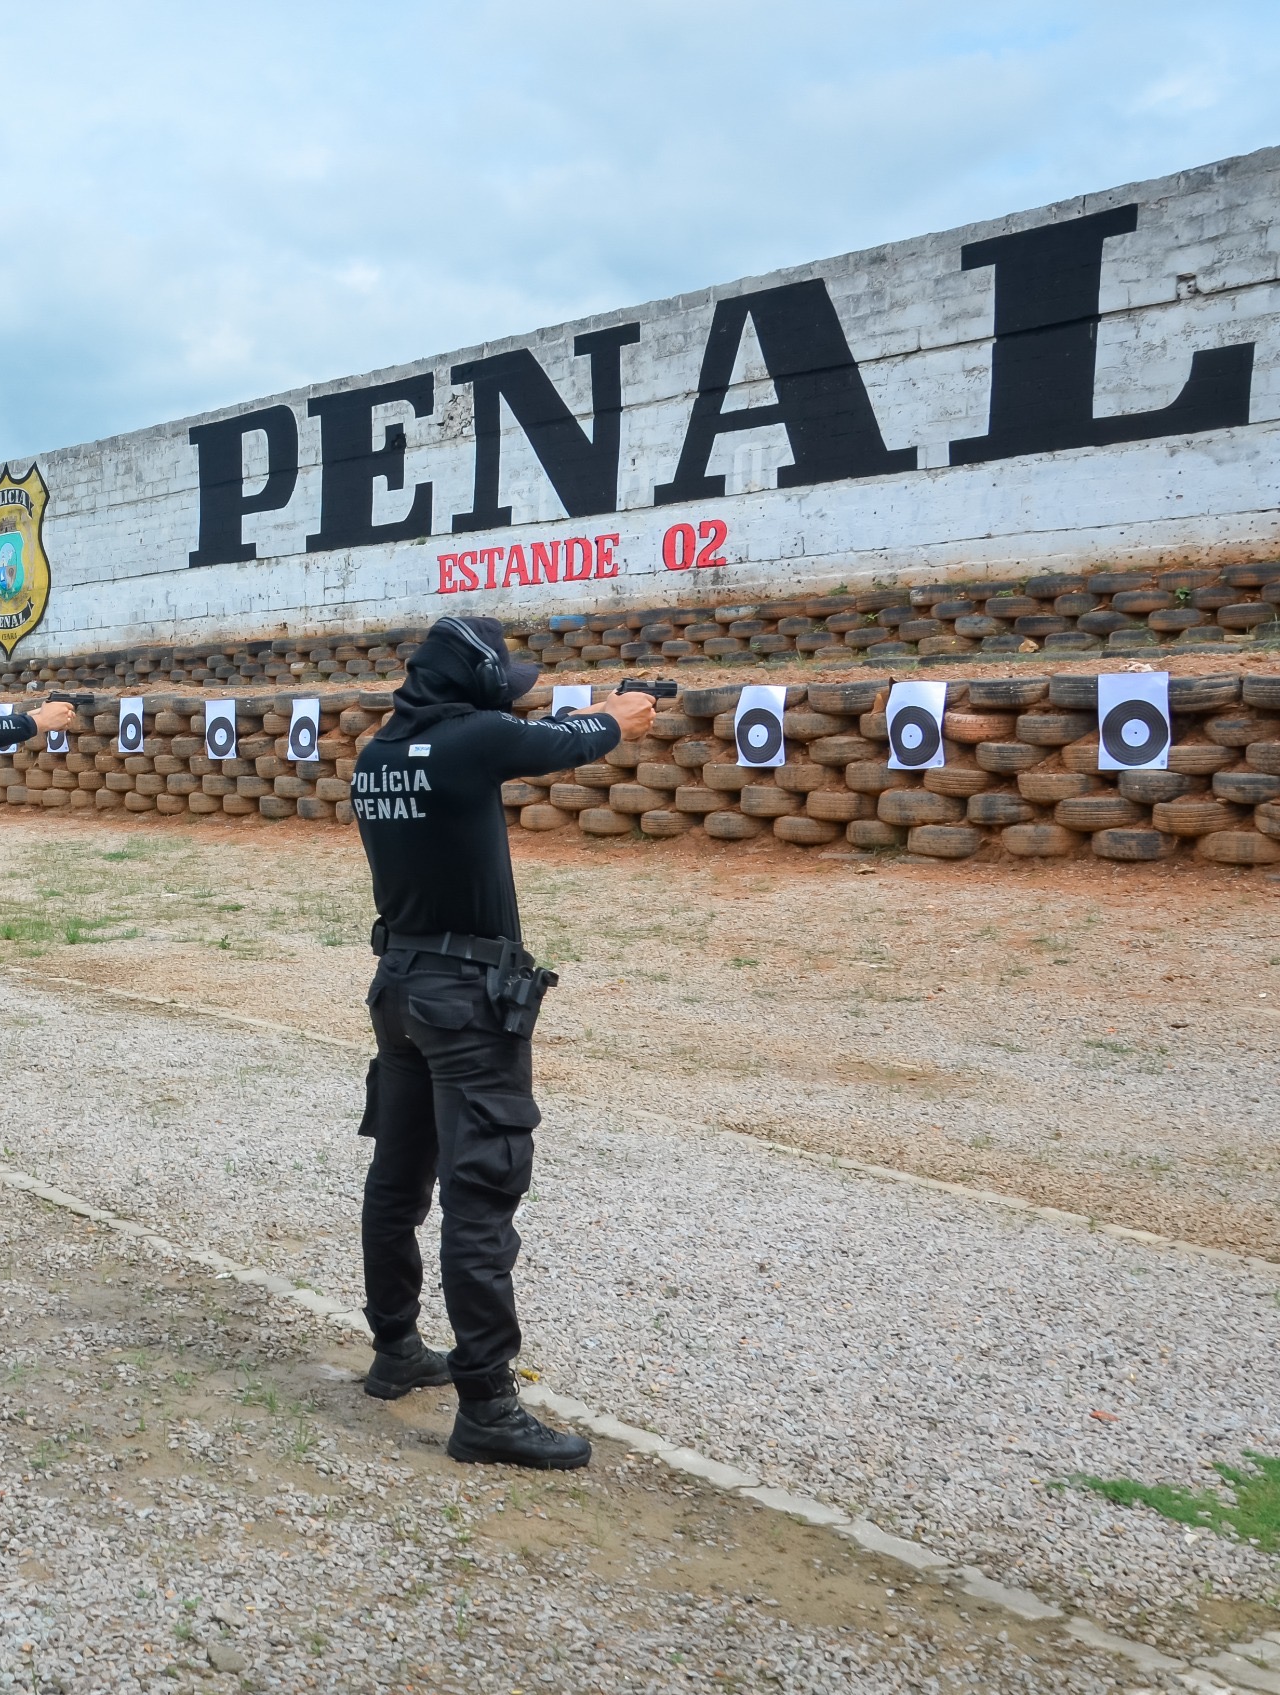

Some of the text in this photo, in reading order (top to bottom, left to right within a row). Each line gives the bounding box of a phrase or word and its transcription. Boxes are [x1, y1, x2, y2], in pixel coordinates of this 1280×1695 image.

[189, 203, 1257, 569] PENAL
[437, 519, 728, 594] ESTANDE 02
[353, 797, 426, 820] PENAL
